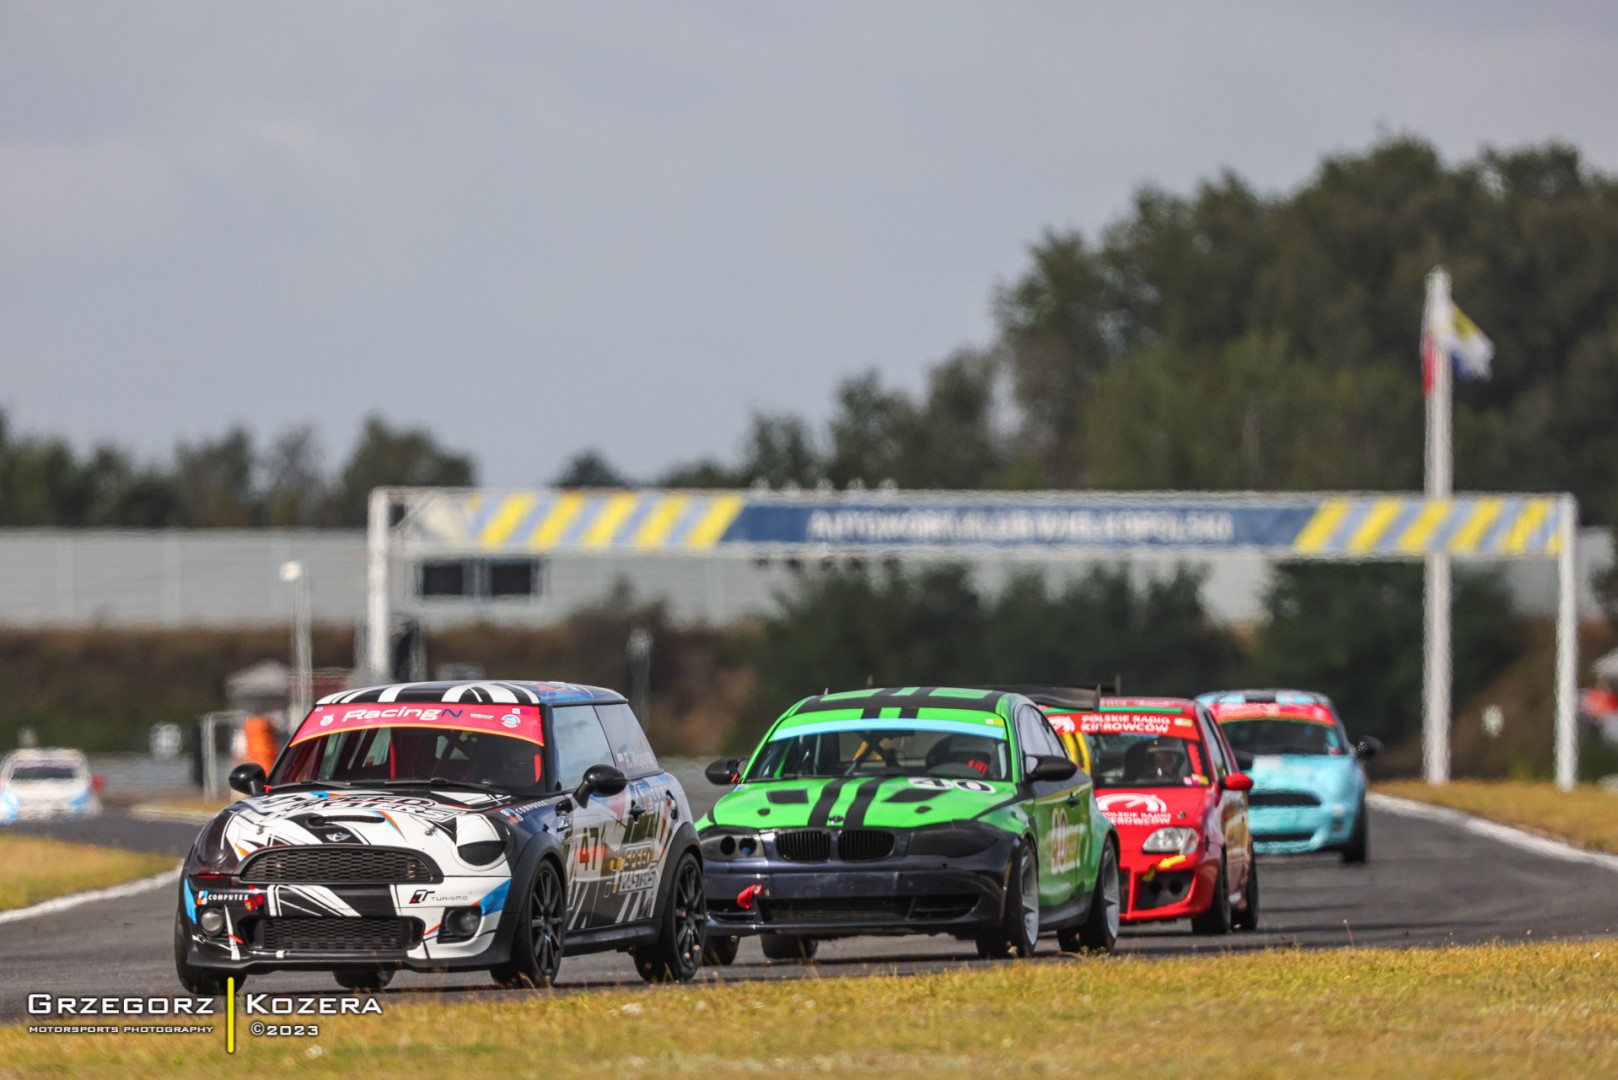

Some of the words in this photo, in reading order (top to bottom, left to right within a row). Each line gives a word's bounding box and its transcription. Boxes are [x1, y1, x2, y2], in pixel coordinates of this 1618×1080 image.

[1081, 714, 1130, 723] POLSKIE
[1132, 715, 1171, 725] RADIO
[908, 777, 996, 793] 40
[579, 827, 599, 871] 47
[623, 848, 653, 870] SPEED
